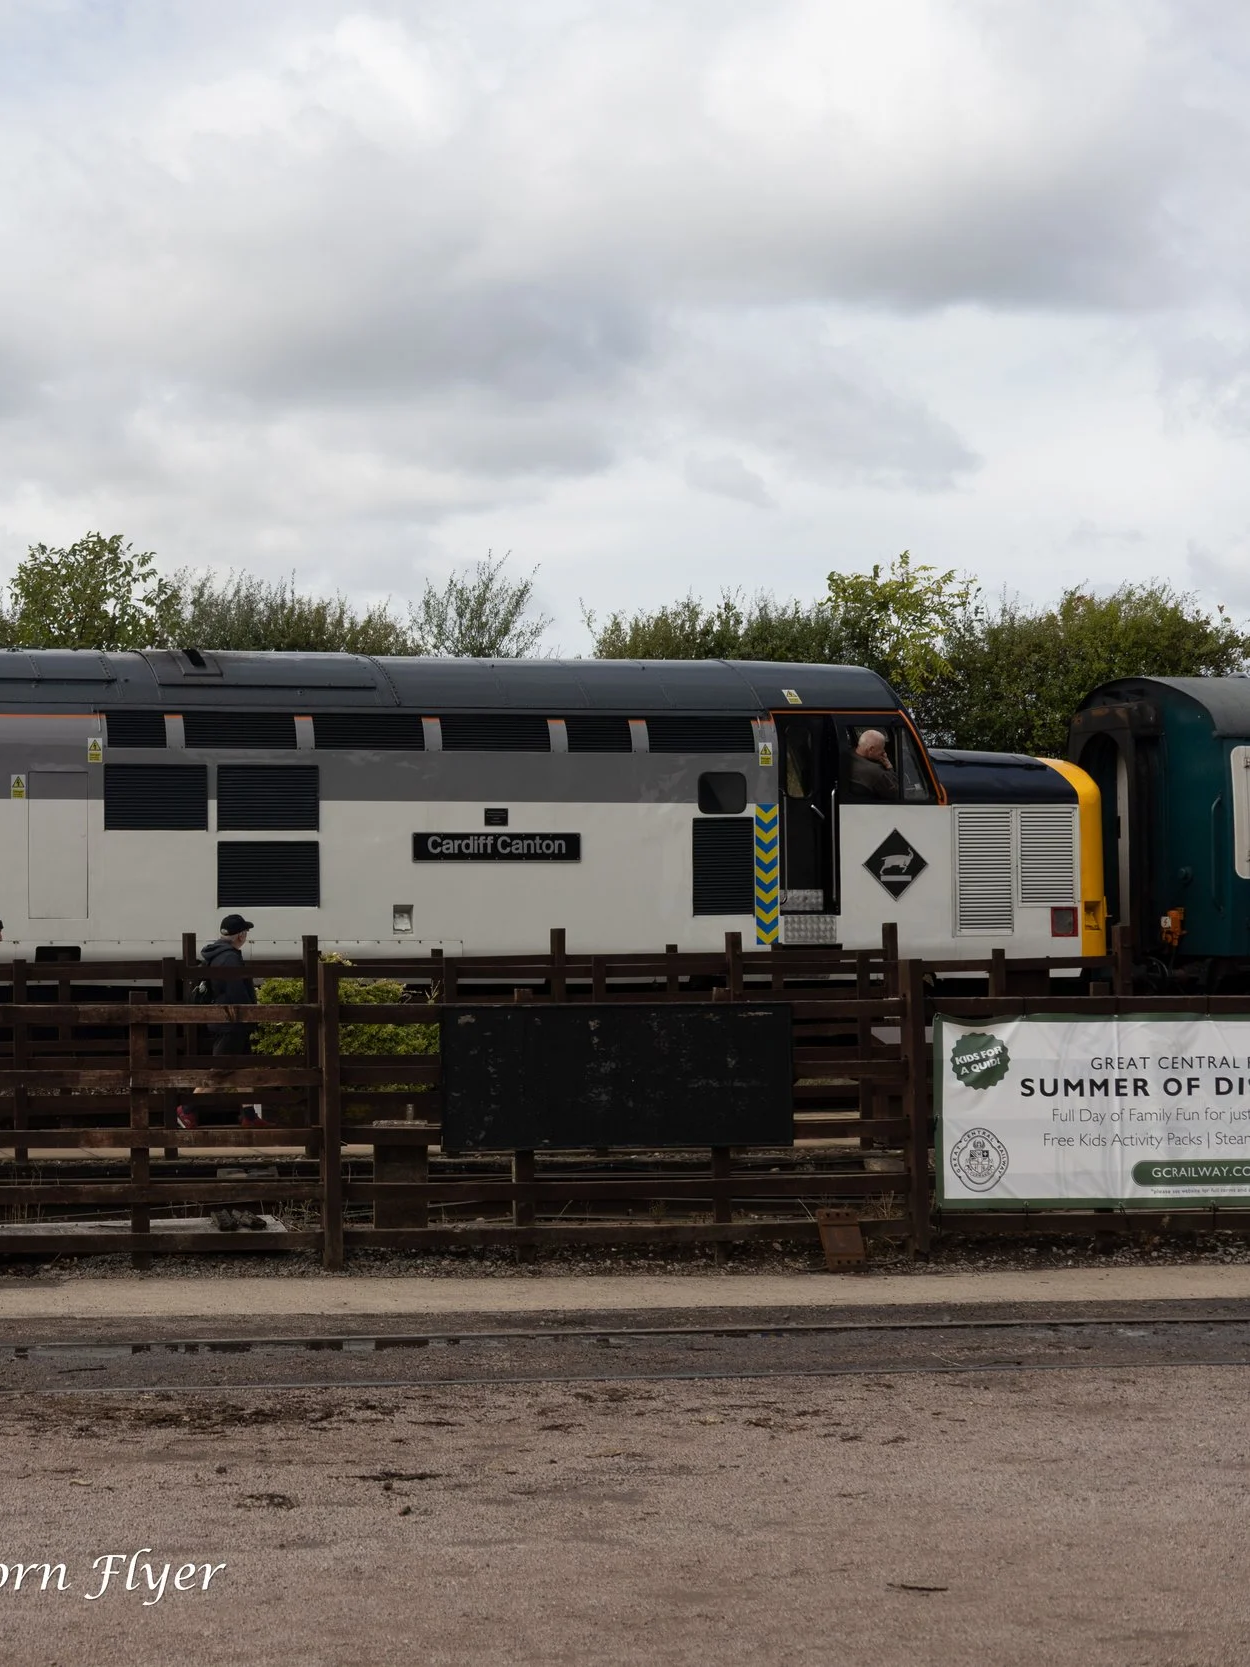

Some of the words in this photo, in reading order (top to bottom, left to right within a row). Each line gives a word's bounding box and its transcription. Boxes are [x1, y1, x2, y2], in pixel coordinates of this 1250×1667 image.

[427, 836, 494, 854] Cardiff
[497, 836, 566, 854] Canton
[955, 1054, 980, 1065] KIDS
[981, 1046, 1003, 1059] FOR
[1091, 1057, 1150, 1069] GREAT
[1158, 1056, 1240, 1069] CENTRAL
[960, 1067, 970, 1075] A
[971, 1058, 1000, 1072] QUID!
[1020, 1078, 1150, 1097] SUMMER
[1163, 1077, 1200, 1096] OF
[1215, 1077, 1250, 1096] DI
[1052, 1108, 1074, 1122] Full
[1080, 1108, 1106, 1125] Day
[1110, 1108, 1125, 1122] of
[1129, 1108, 1172, 1125] Family
[1176, 1108, 1199, 1121] Fun
[1205, 1107, 1226, 1120] for
[964, 1130, 995, 1142] CENTRAL
[1044, 1133, 1075, 1146] Free
[1080, 1133, 1107, 1146] Kids
[1111, 1133, 1163, 1149] Activity
[1167, 1132, 1202, 1145] Packs
